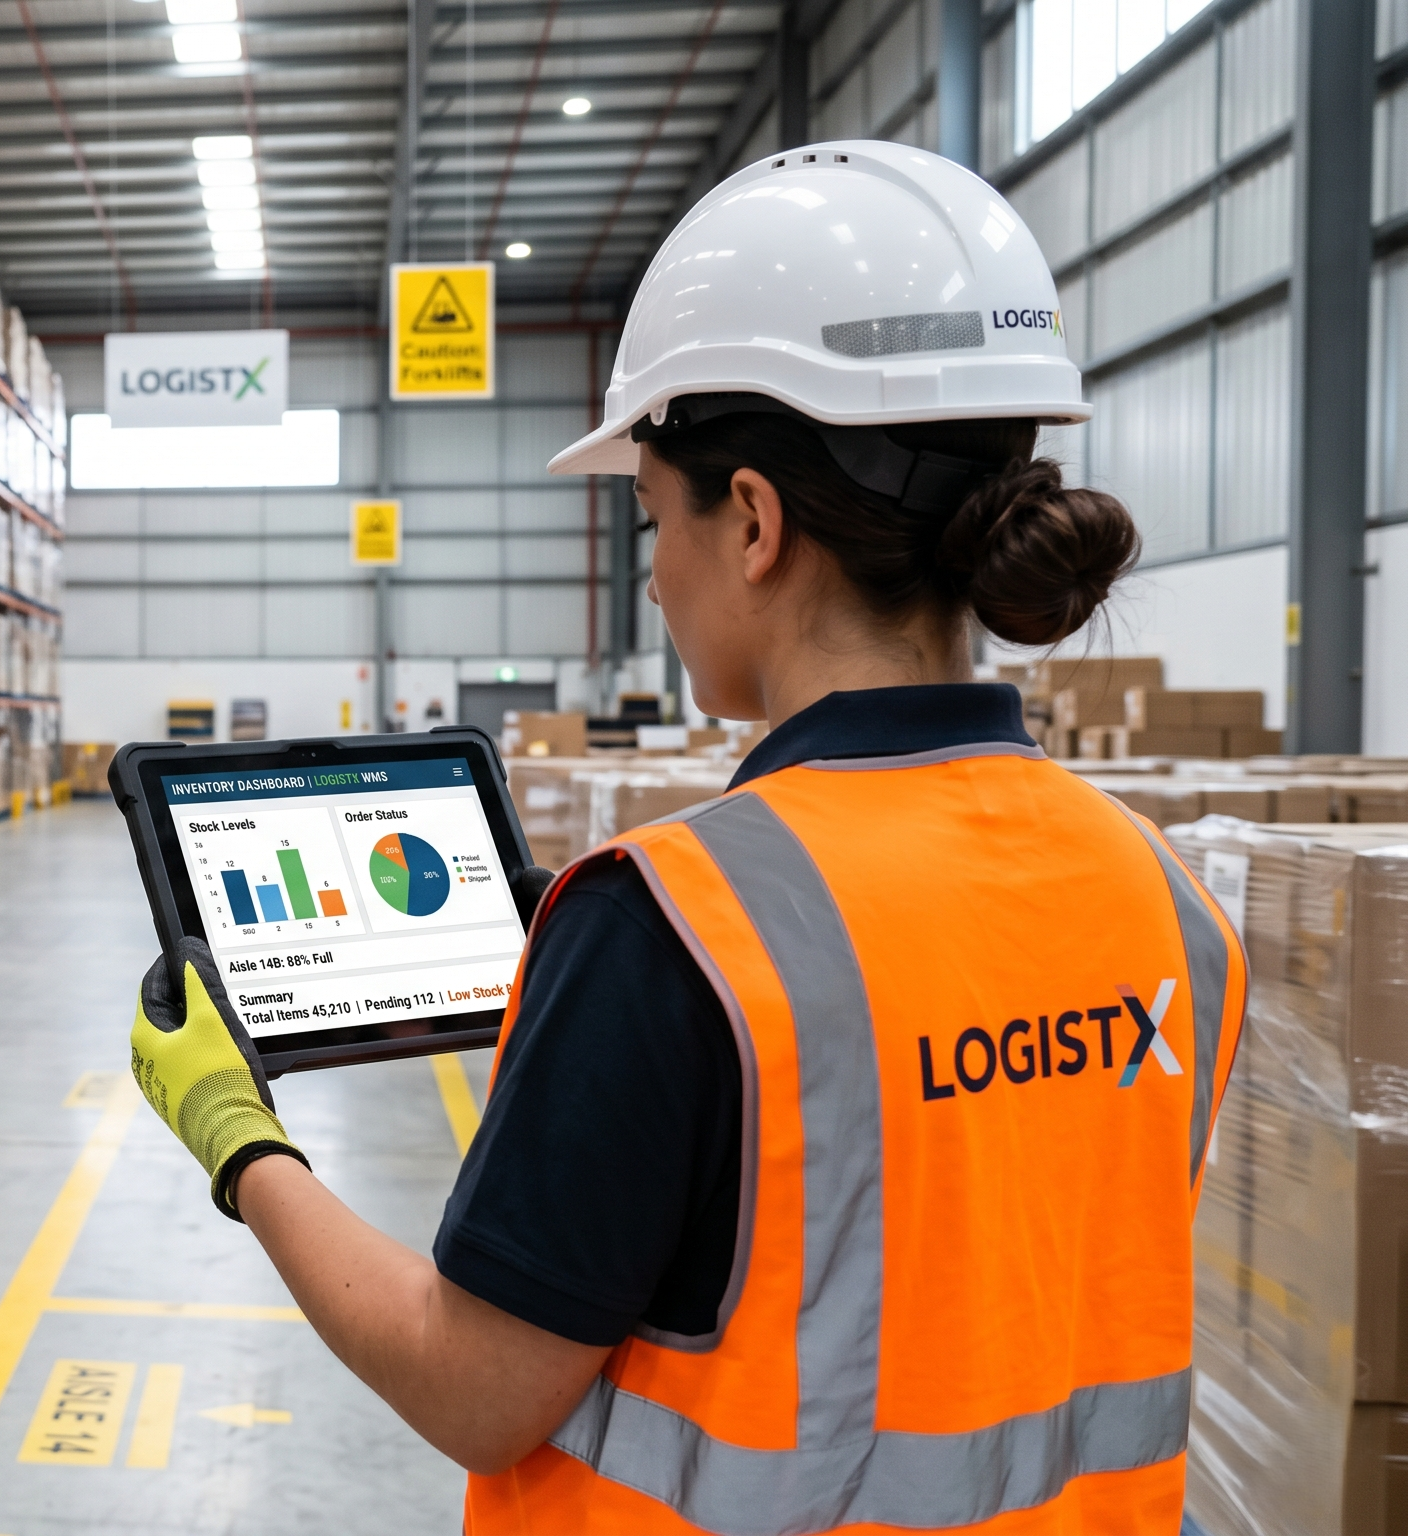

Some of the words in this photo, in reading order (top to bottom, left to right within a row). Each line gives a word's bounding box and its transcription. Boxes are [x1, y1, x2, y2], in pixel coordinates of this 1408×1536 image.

[993, 309, 1063, 338] LOGISTX
[121, 356, 270, 400] LOGISTX
[171, 780, 234, 796] INVENTORY
[237, 776, 305, 792] DASHBOARD
[313, 773, 360, 787] LOGISTX
[360, 771, 388, 784] WMS
[189, 820, 220, 833] Stock
[221, 819, 256, 832] Levels
[345, 810, 373, 823] Order
[375, 809, 408, 821] Status
[229, 960, 258, 974] Aisle
[259, 957, 285, 970] 14B:
[286, 954, 311, 967] 88%
[312, 951, 334, 964] Full
[238, 992, 294, 1007] Summary
[243, 1009, 274, 1025] Total
[276, 1008, 310, 1022] Items
[312, 1001, 352, 1018] 45,210
[365, 996, 412, 1011] Pending
[413, 992, 436, 1006] 112
[447, 990, 471, 1002] Low
[472, 984, 505, 998] Stock
[918, 978, 1185, 1102] LOGISTX
[53, 1365, 117, 1422] AISLE
[39, 1433, 98, 1453] 14
